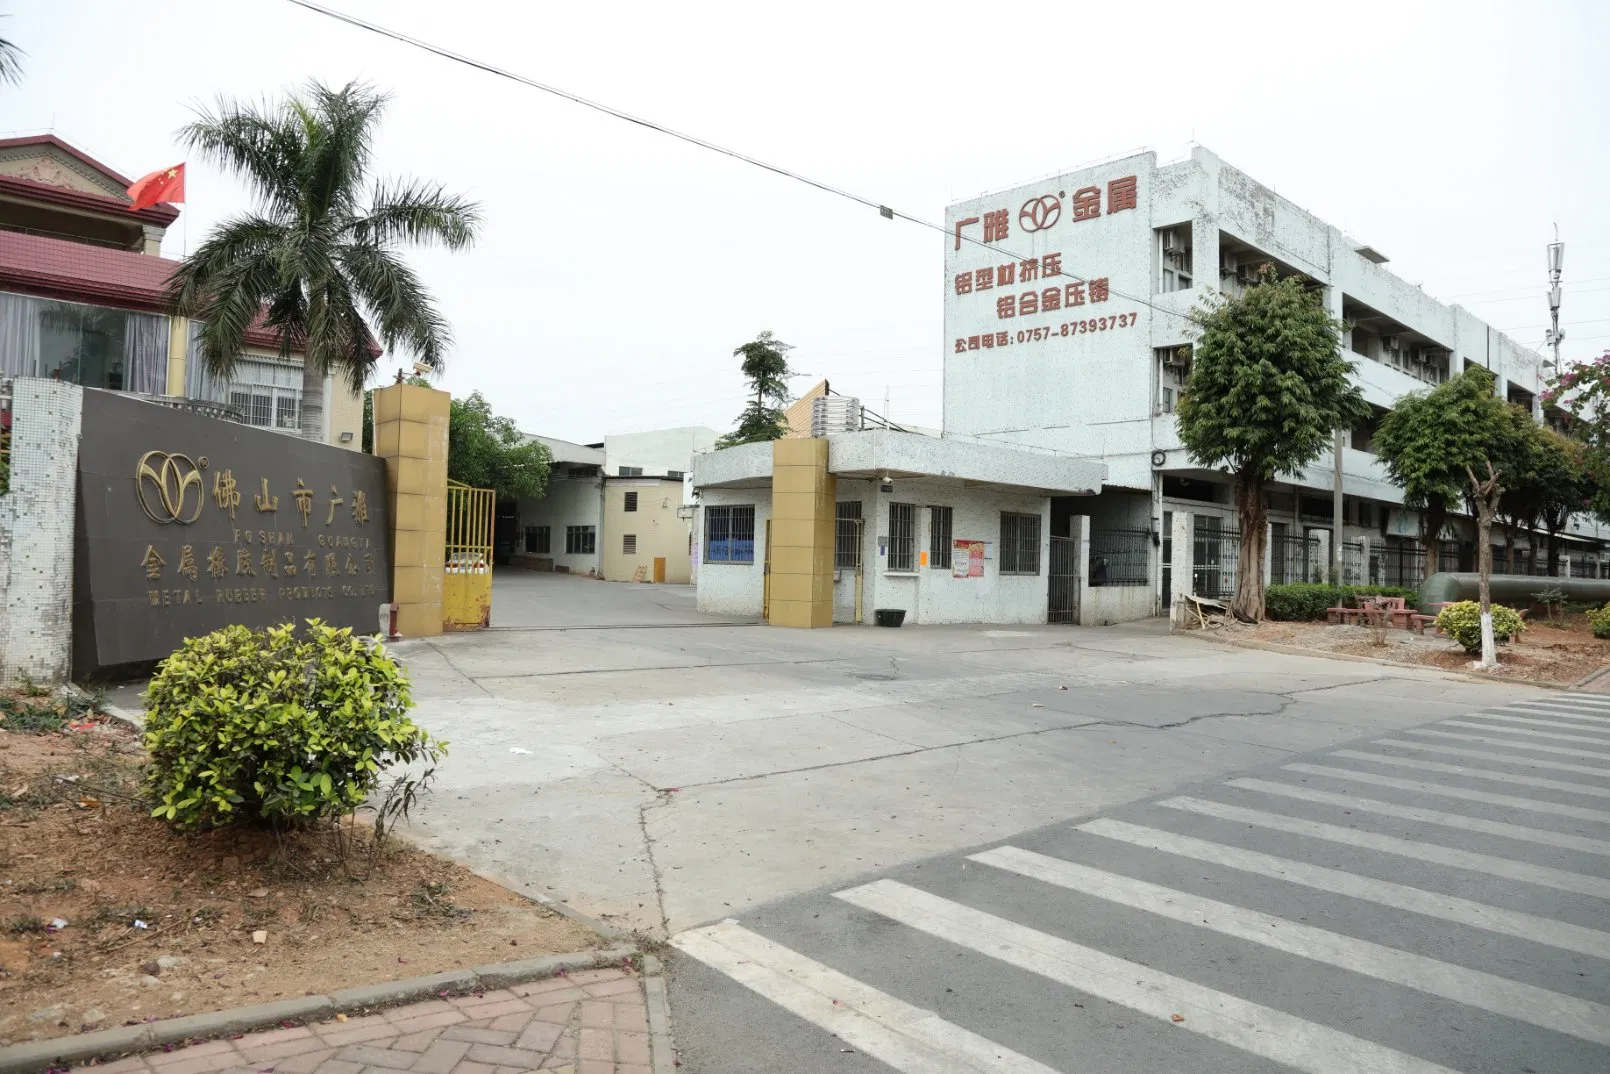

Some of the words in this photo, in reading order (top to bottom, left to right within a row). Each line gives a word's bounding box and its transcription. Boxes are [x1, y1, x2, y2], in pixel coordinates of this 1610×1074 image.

[954, 208, 1009, 251] 广雅
[1072, 175, 1138, 222] 金属
[954, 252, 1062, 295] 铝型材挤压
[996, 277, 1109, 319] 铝合金压铸
[212, 468, 370, 528] 佛山市广雅
[148, 589, 203, 607] METAL
[215, 587, 266, 603] RUBBER
